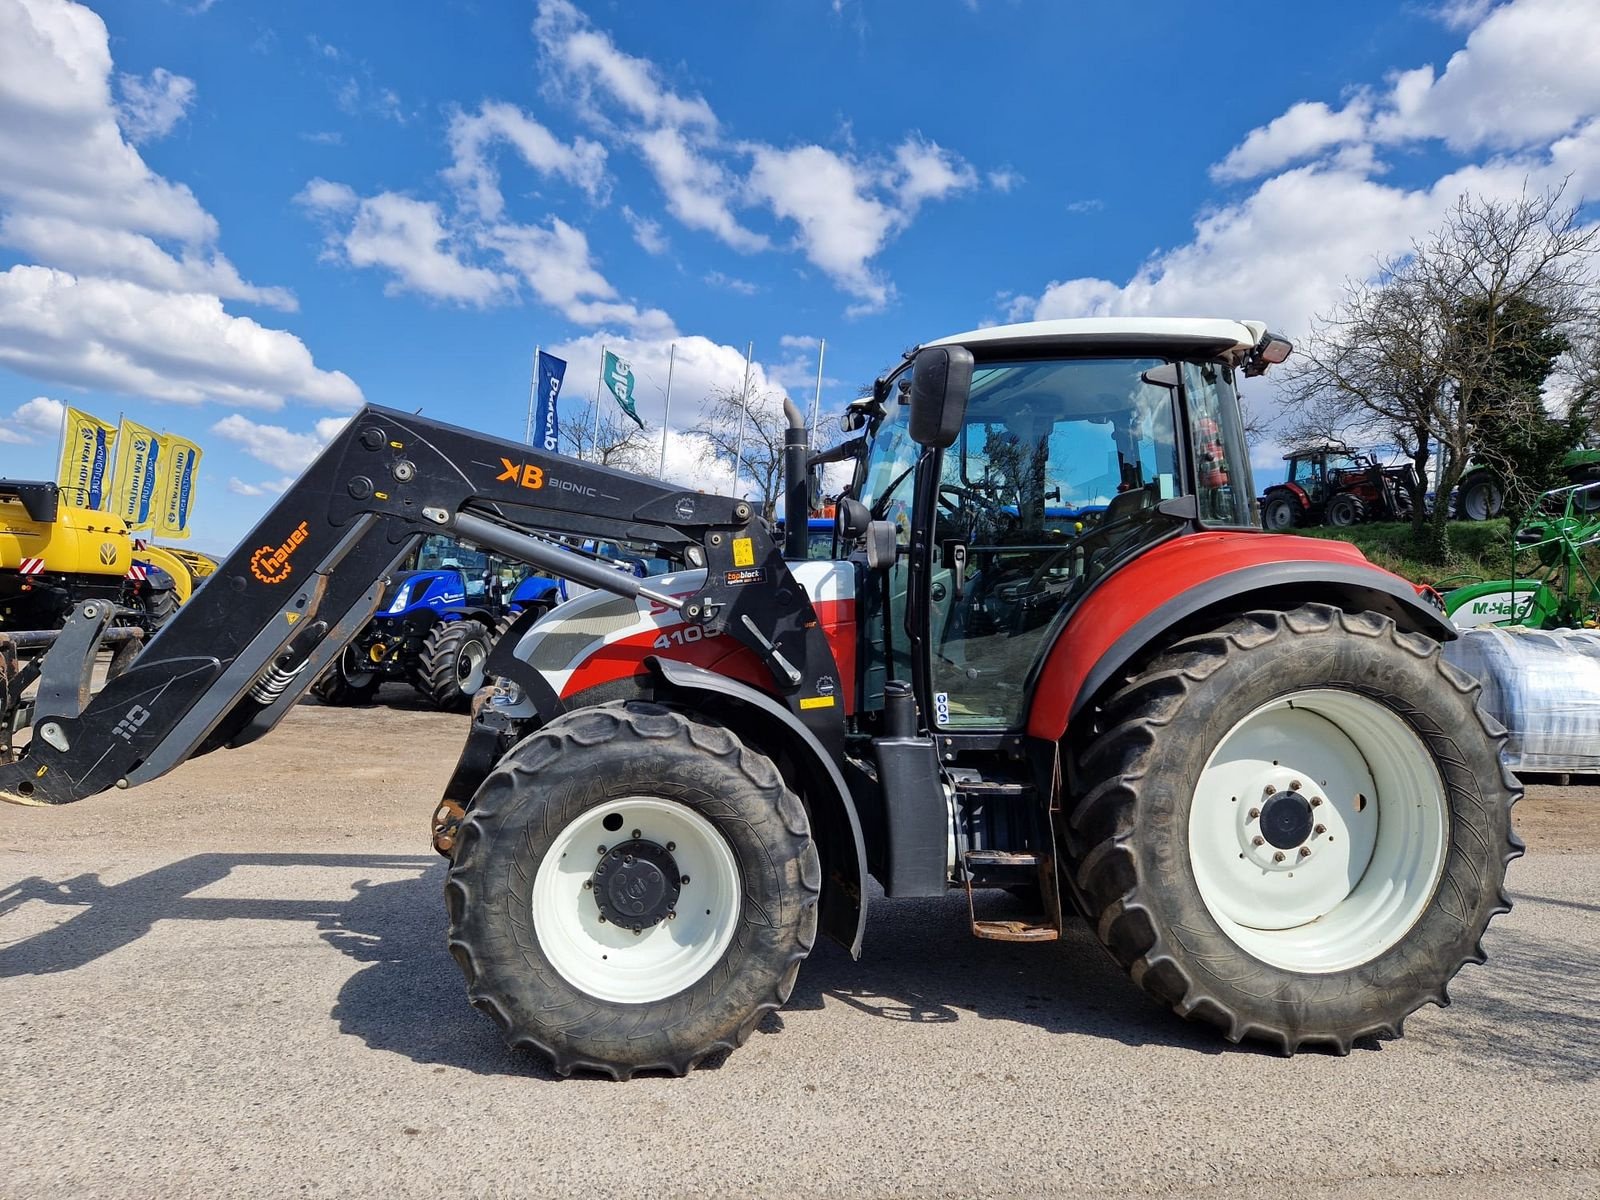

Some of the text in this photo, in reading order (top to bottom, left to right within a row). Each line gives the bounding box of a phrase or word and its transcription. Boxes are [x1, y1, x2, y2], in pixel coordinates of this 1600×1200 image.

[170, 452, 184, 511] NEW HOLLAND
[180, 468, 190, 513] AGRICULTURE
[548, 477, 597, 497] BIONIC
[260, 520, 308, 574] hauer
[111, 704, 150, 740] 110
